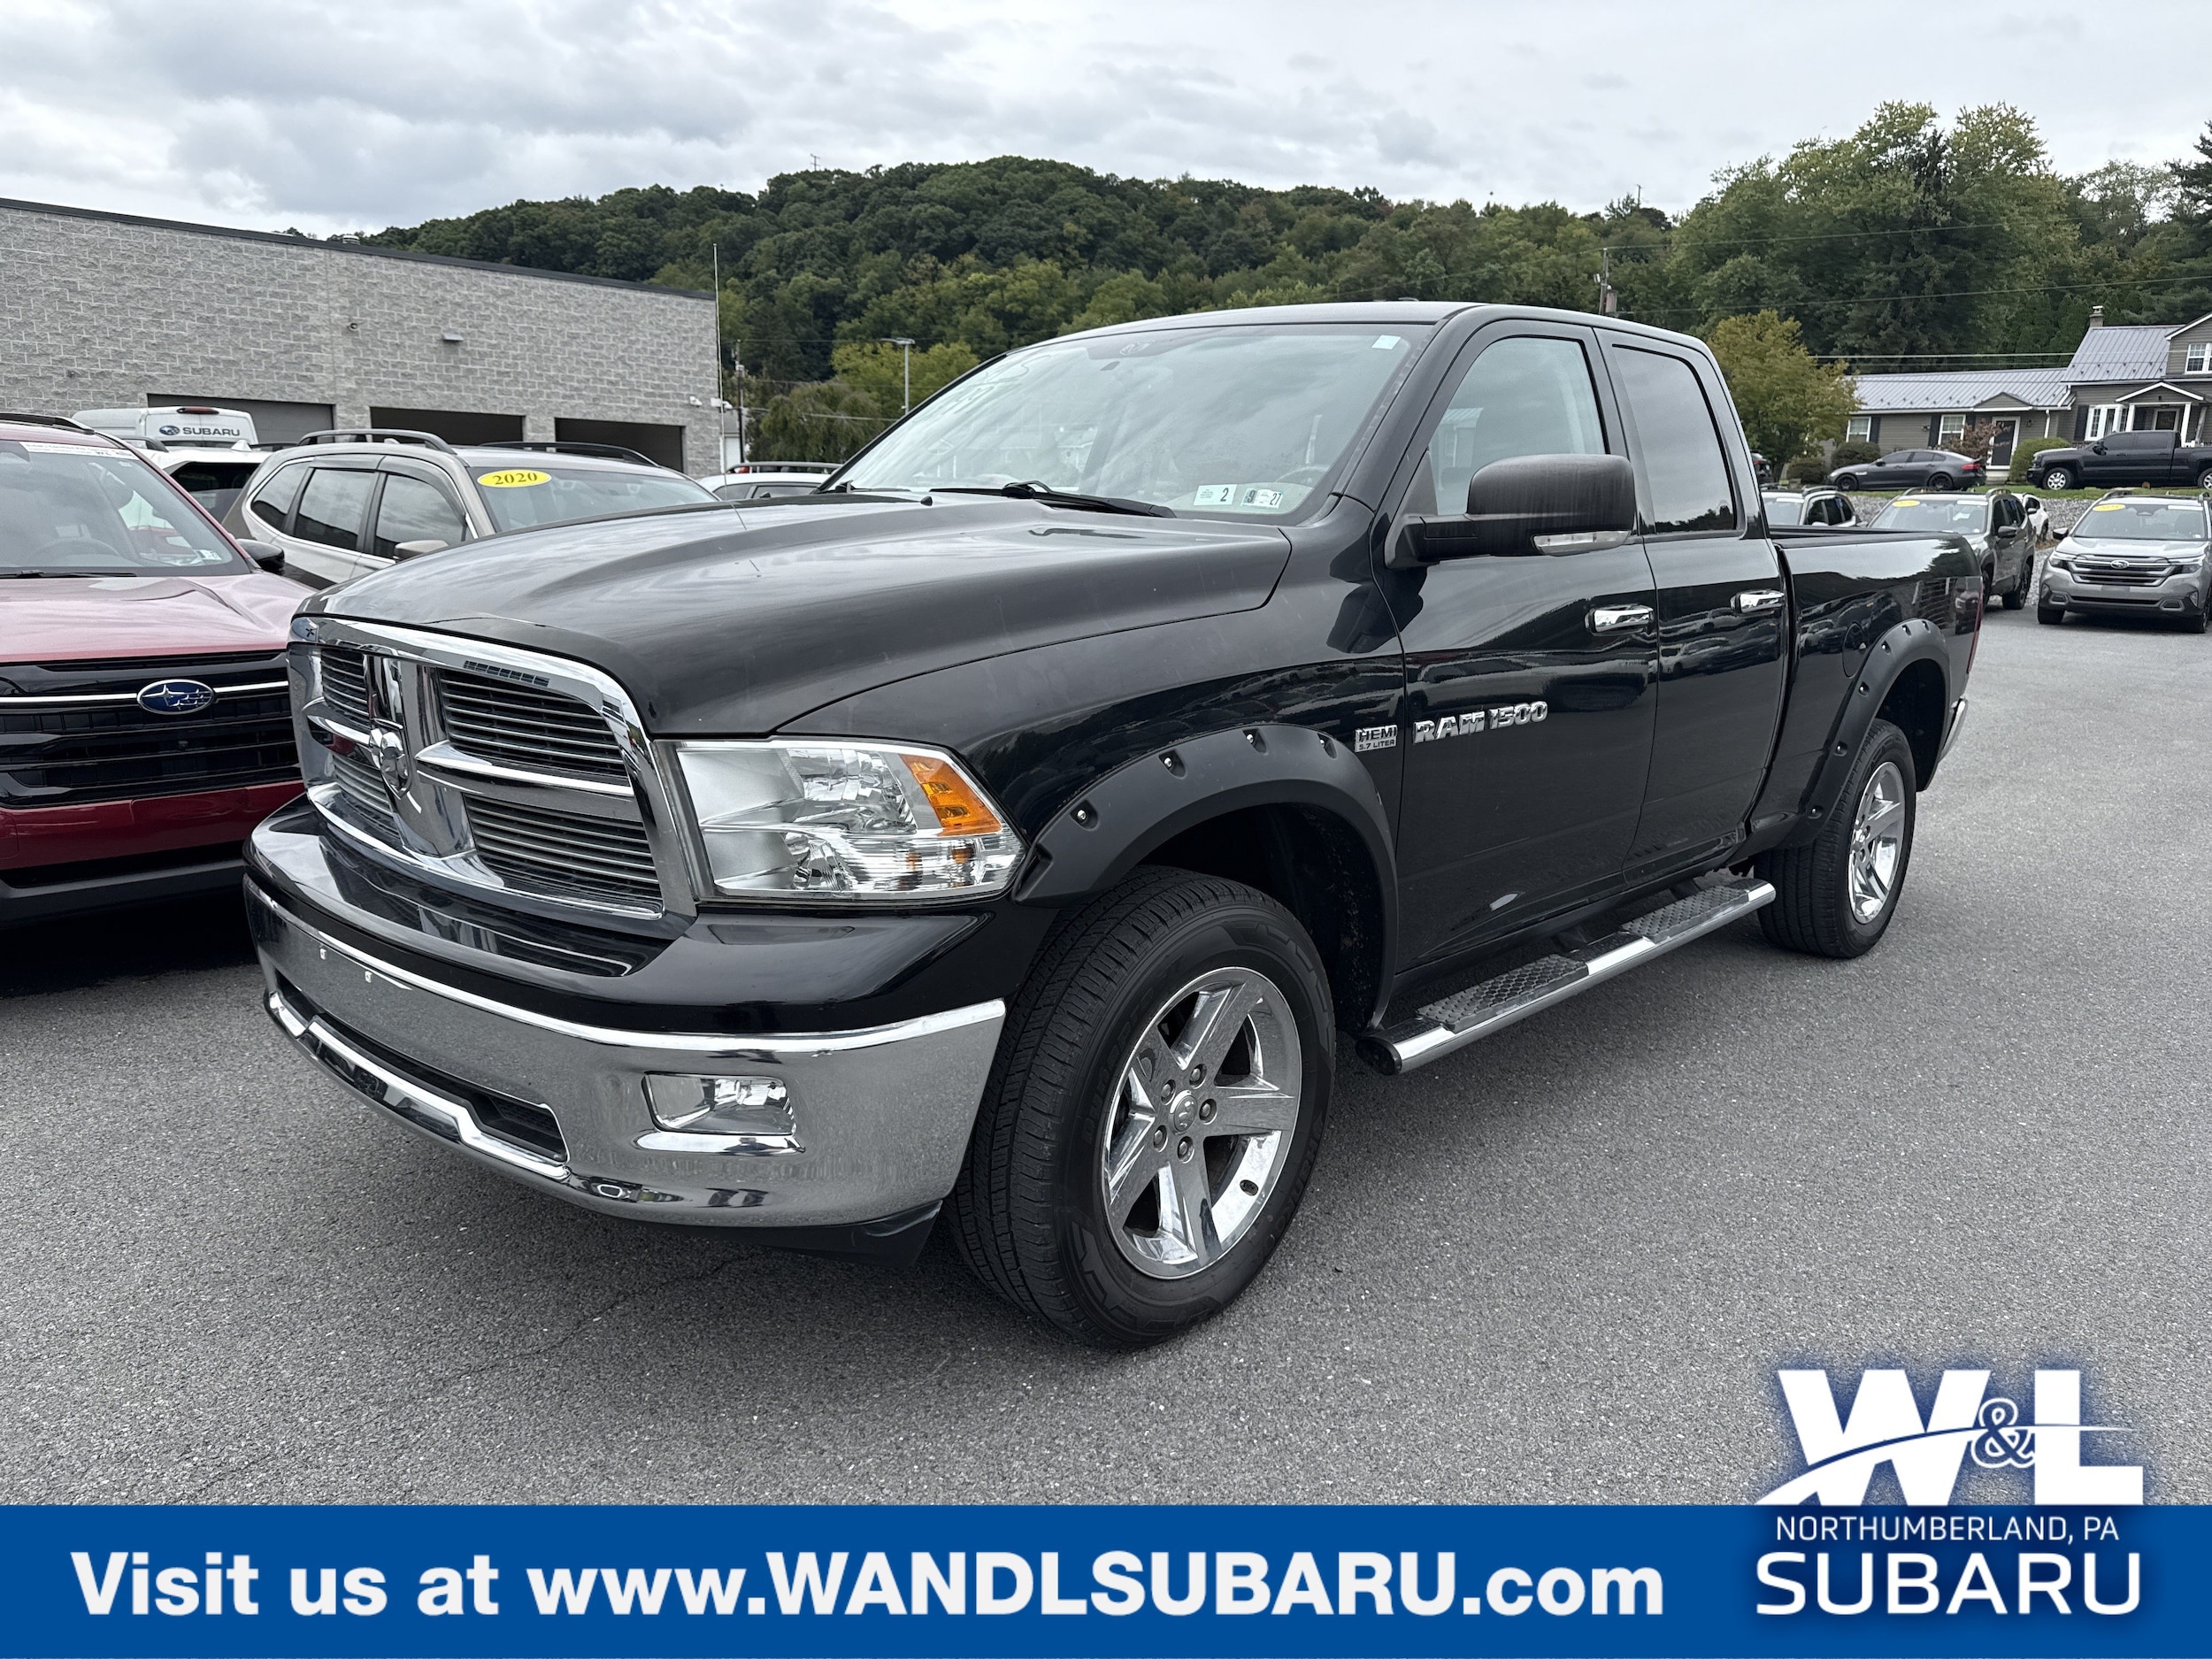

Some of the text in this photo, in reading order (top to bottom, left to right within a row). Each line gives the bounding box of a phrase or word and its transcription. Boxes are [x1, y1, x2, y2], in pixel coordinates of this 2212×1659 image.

[182, 426, 241, 436] SUBARU
[493, 472, 538, 485] 2020
[1220, 487, 1229, 503] 2
[1247, 489, 1256, 503] 9
[1270, 493, 1282, 505] 27
[1413, 701, 1548, 744] RAM 1500
[1356, 725, 1398, 742] HEMI
[1372, 739, 1396, 749] LITER
